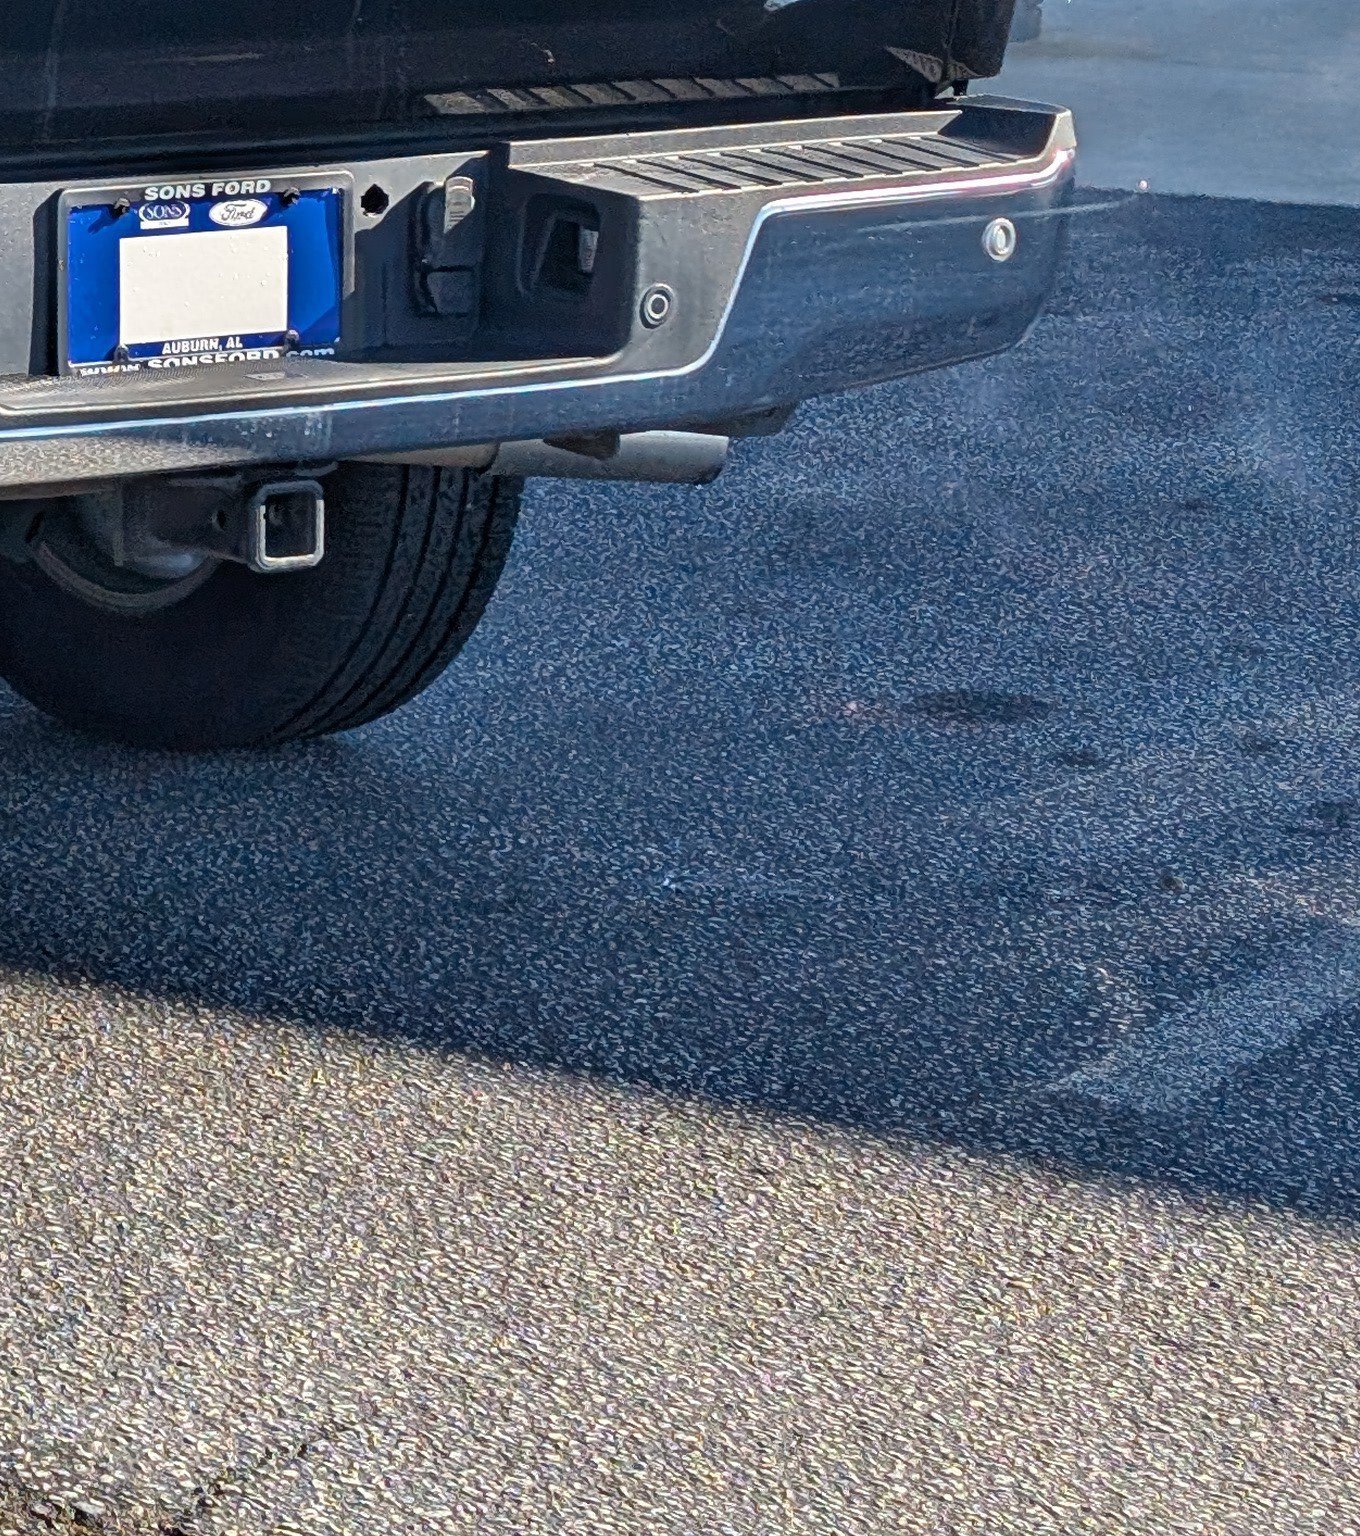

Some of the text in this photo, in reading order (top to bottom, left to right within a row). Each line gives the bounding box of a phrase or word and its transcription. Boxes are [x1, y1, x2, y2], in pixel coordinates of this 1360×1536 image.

[144, 178, 272, 201] SONS FORD
[220, 202, 257, 222] Ford
[161, 335, 243, 355] AUBURN, AL
